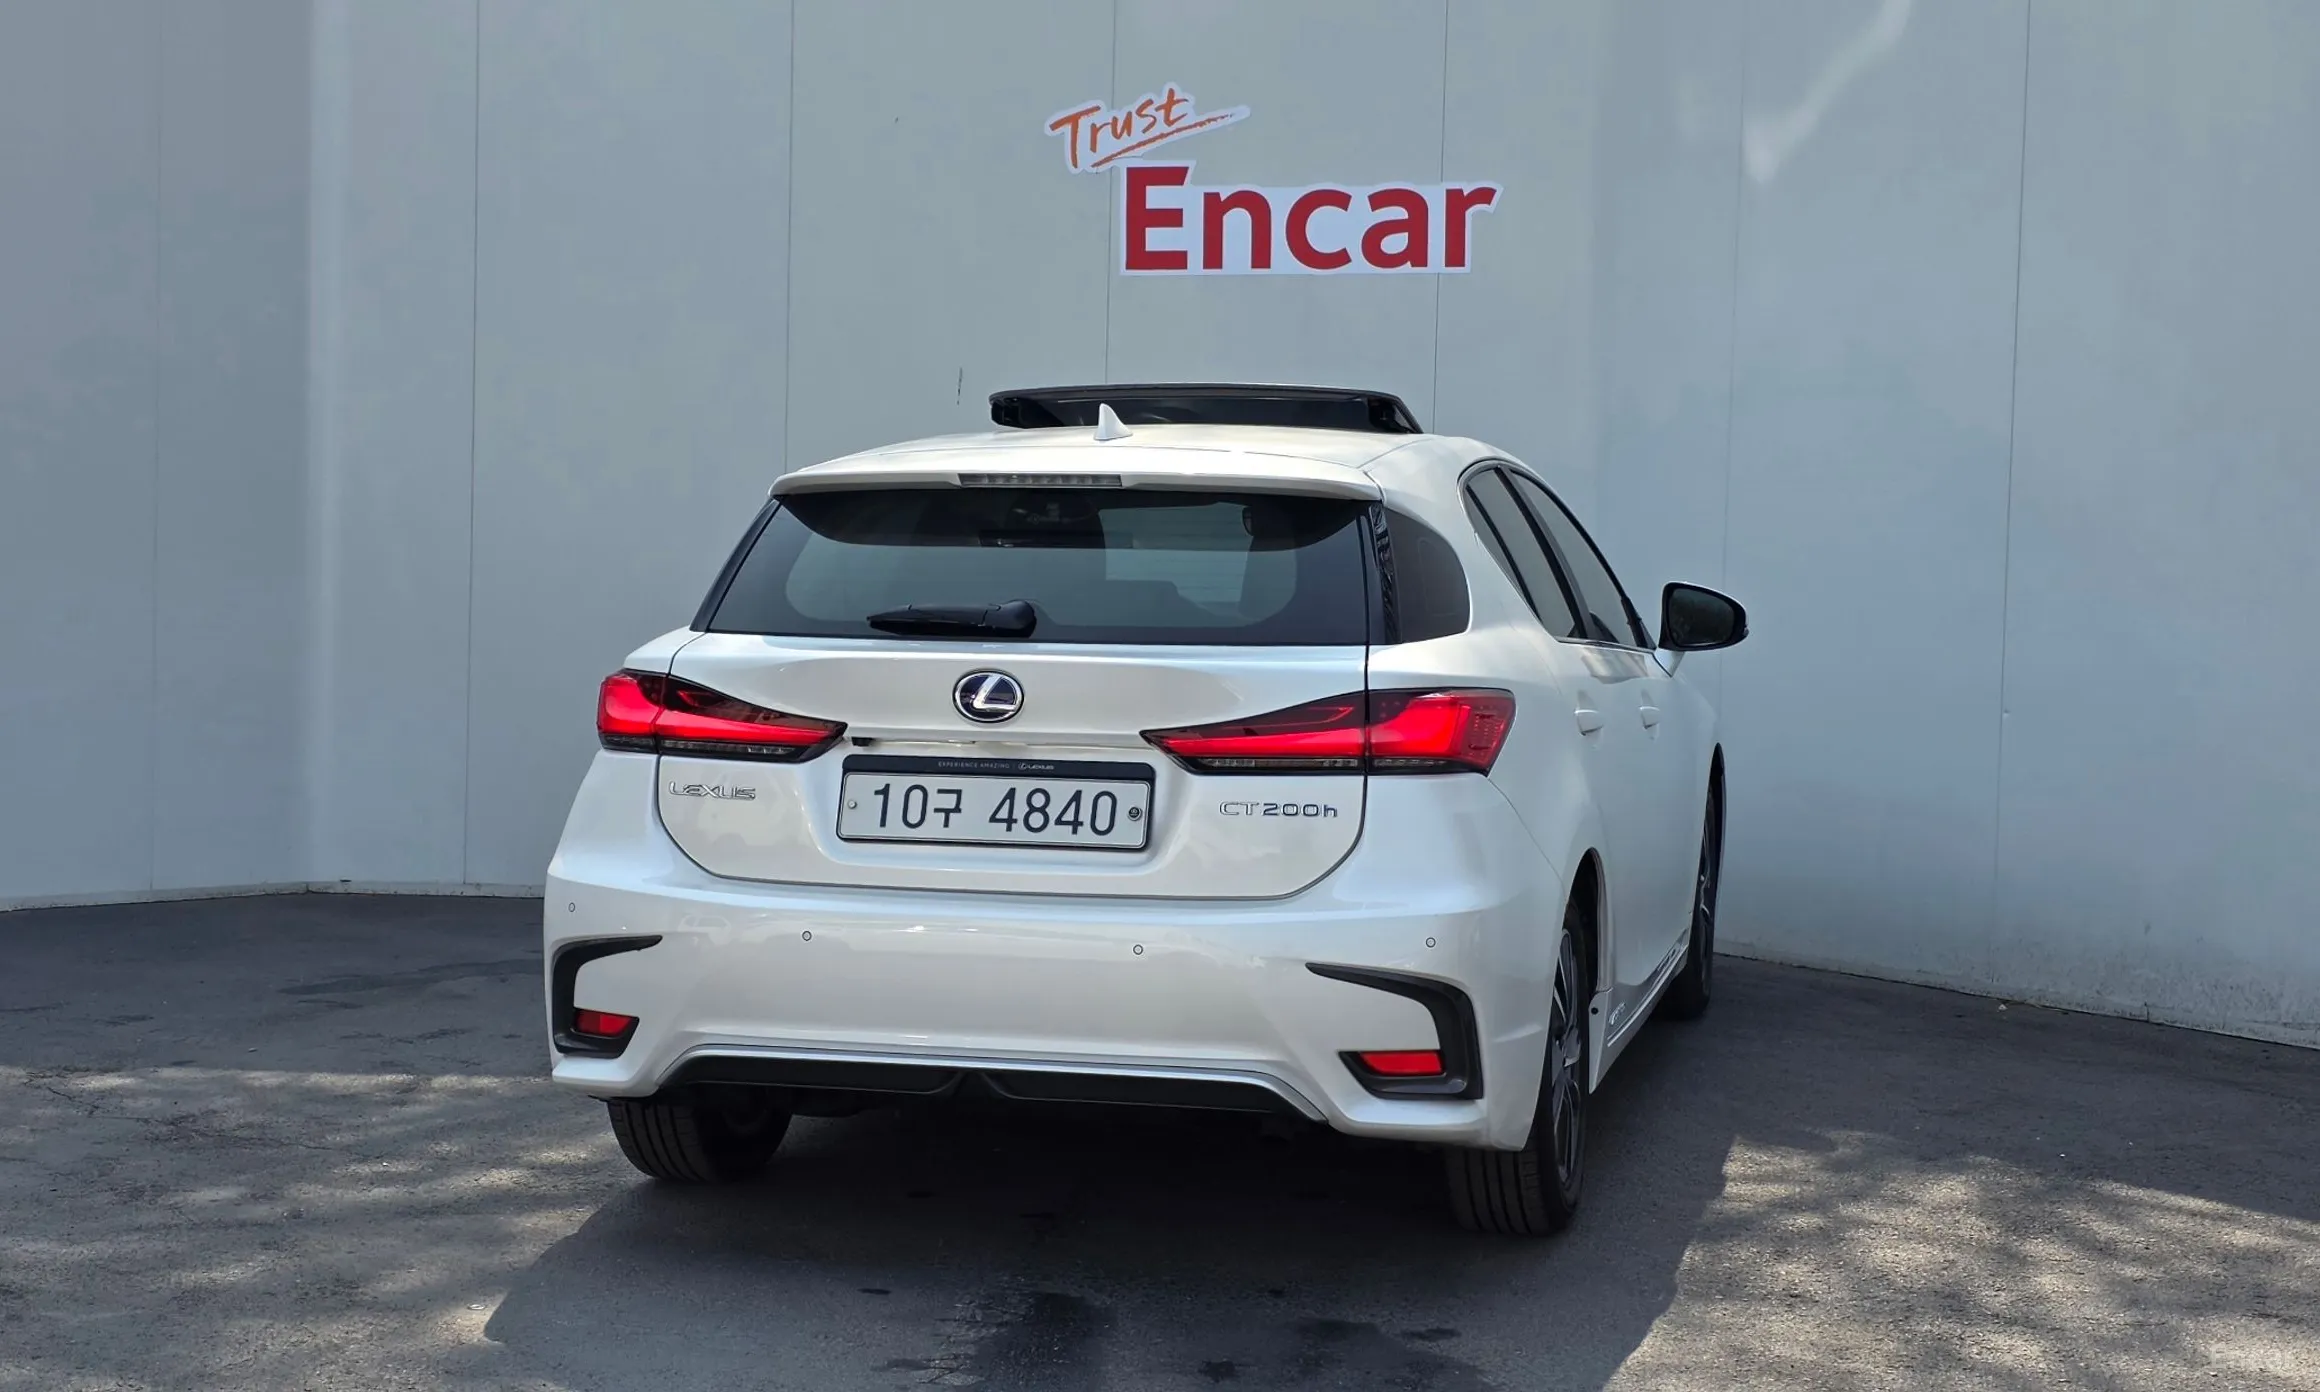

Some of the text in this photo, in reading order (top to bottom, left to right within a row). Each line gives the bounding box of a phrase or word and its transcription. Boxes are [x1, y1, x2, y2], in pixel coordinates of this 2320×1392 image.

[1050, 87, 1190, 169] Trust
[1125, 166, 1497, 270] Encar
[669, 781, 756, 800] LEXUS
[938, 761, 978, 769] EXPERIENCE
[873, 782, 1118, 836] 10구 4840
